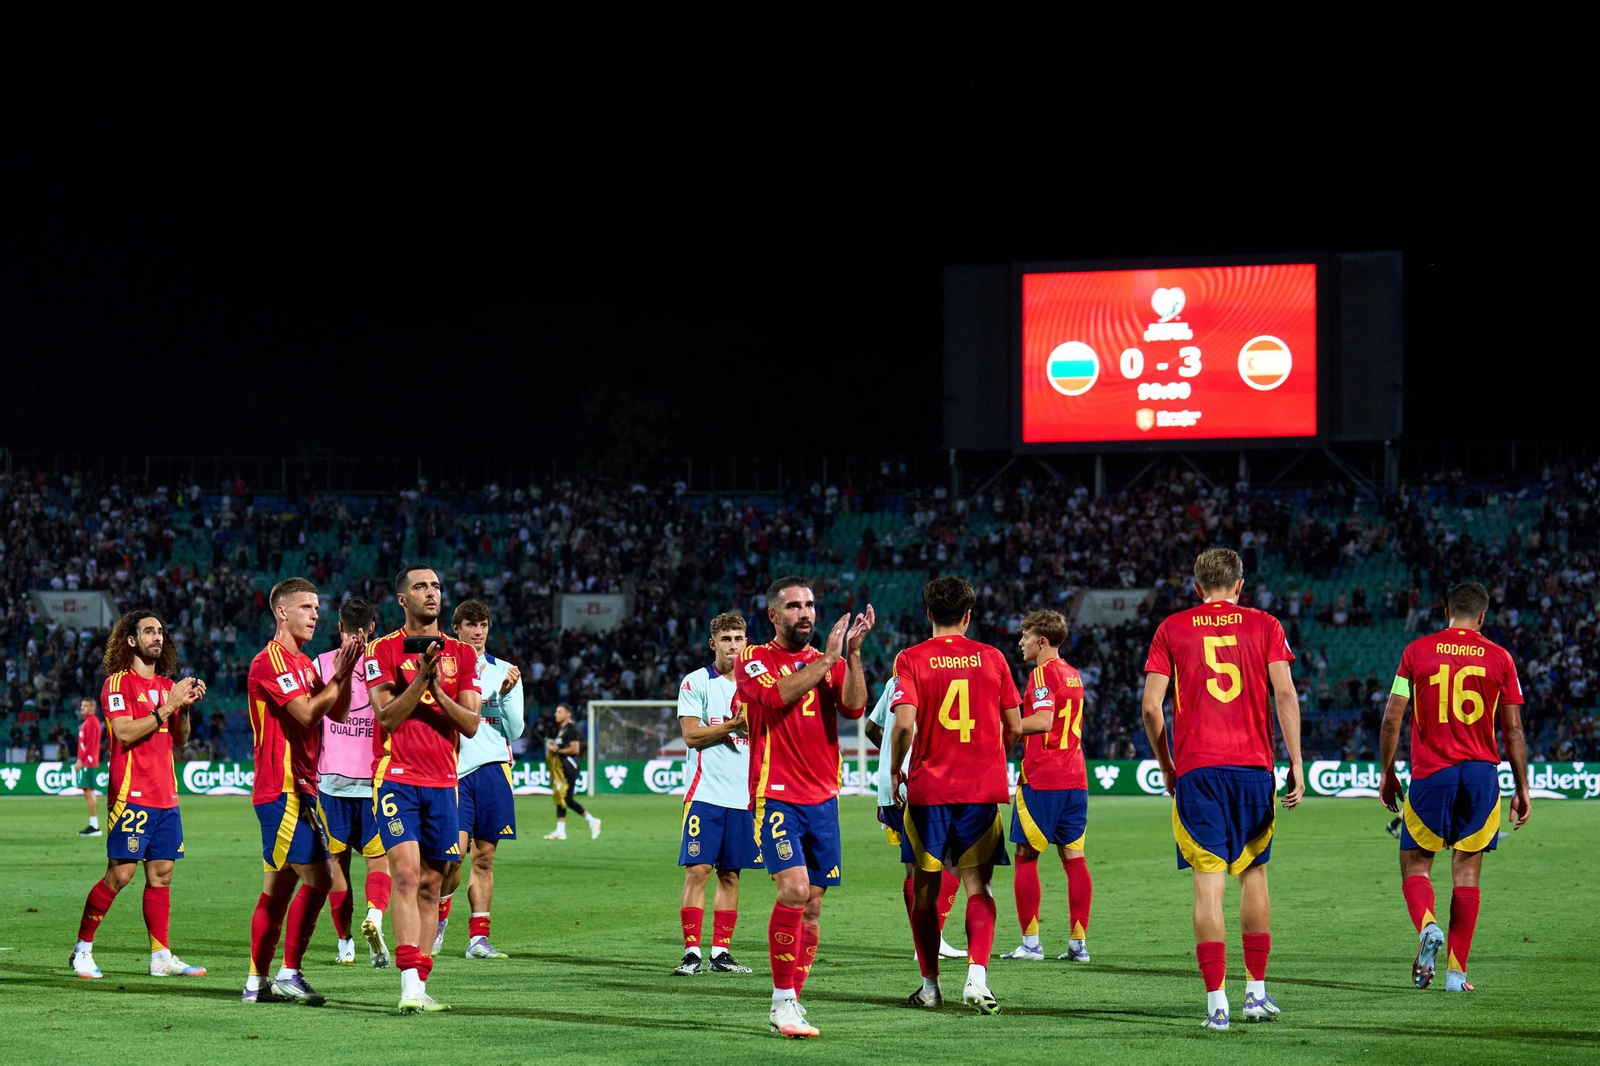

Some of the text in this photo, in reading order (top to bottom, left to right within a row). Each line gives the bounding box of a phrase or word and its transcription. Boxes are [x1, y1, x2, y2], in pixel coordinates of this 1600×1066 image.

[1120, 348, 1144, 379] 0
[1178, 346, 1202, 377] 3
[1192, 613, 1243, 627] HUIJSEN
[929, 652, 982, 669] CUBARSÍ
[1436, 643, 1485, 657] RODRIGO
[1203, 635, 1243, 703] 5
[802, 690, 815, 716] 2
[1429, 664, 1486, 725] 16
[938, 679, 975, 743] 4
[1058, 699, 1084, 749] 14
[381, 793, 398, 817] 6
[122, 809, 148, 834] 22
[688, 815, 700, 837] 8
[769, 812, 787, 839] 2
